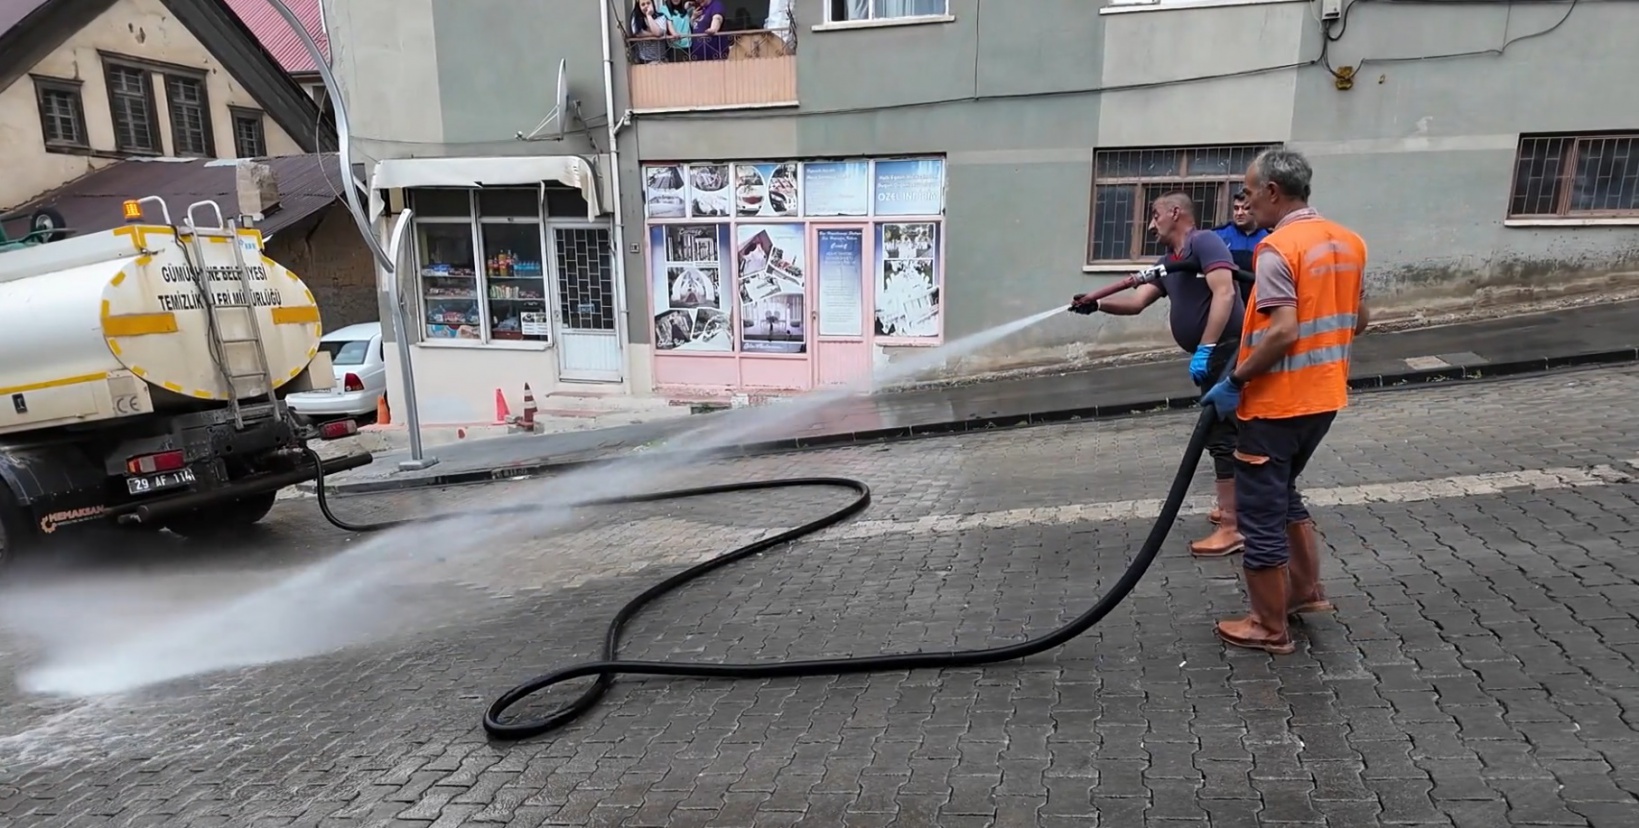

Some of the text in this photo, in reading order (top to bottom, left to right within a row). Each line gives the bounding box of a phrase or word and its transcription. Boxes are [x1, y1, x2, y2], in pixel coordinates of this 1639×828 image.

[220, 263, 268, 281] BELEİYESİ
[158, 290, 204, 311] TEMİZLİK
[233, 288, 282, 307] MÜÜRLÜĞÜ
[134, 478, 150, 490] 29
[155, 474, 166, 487] AF
